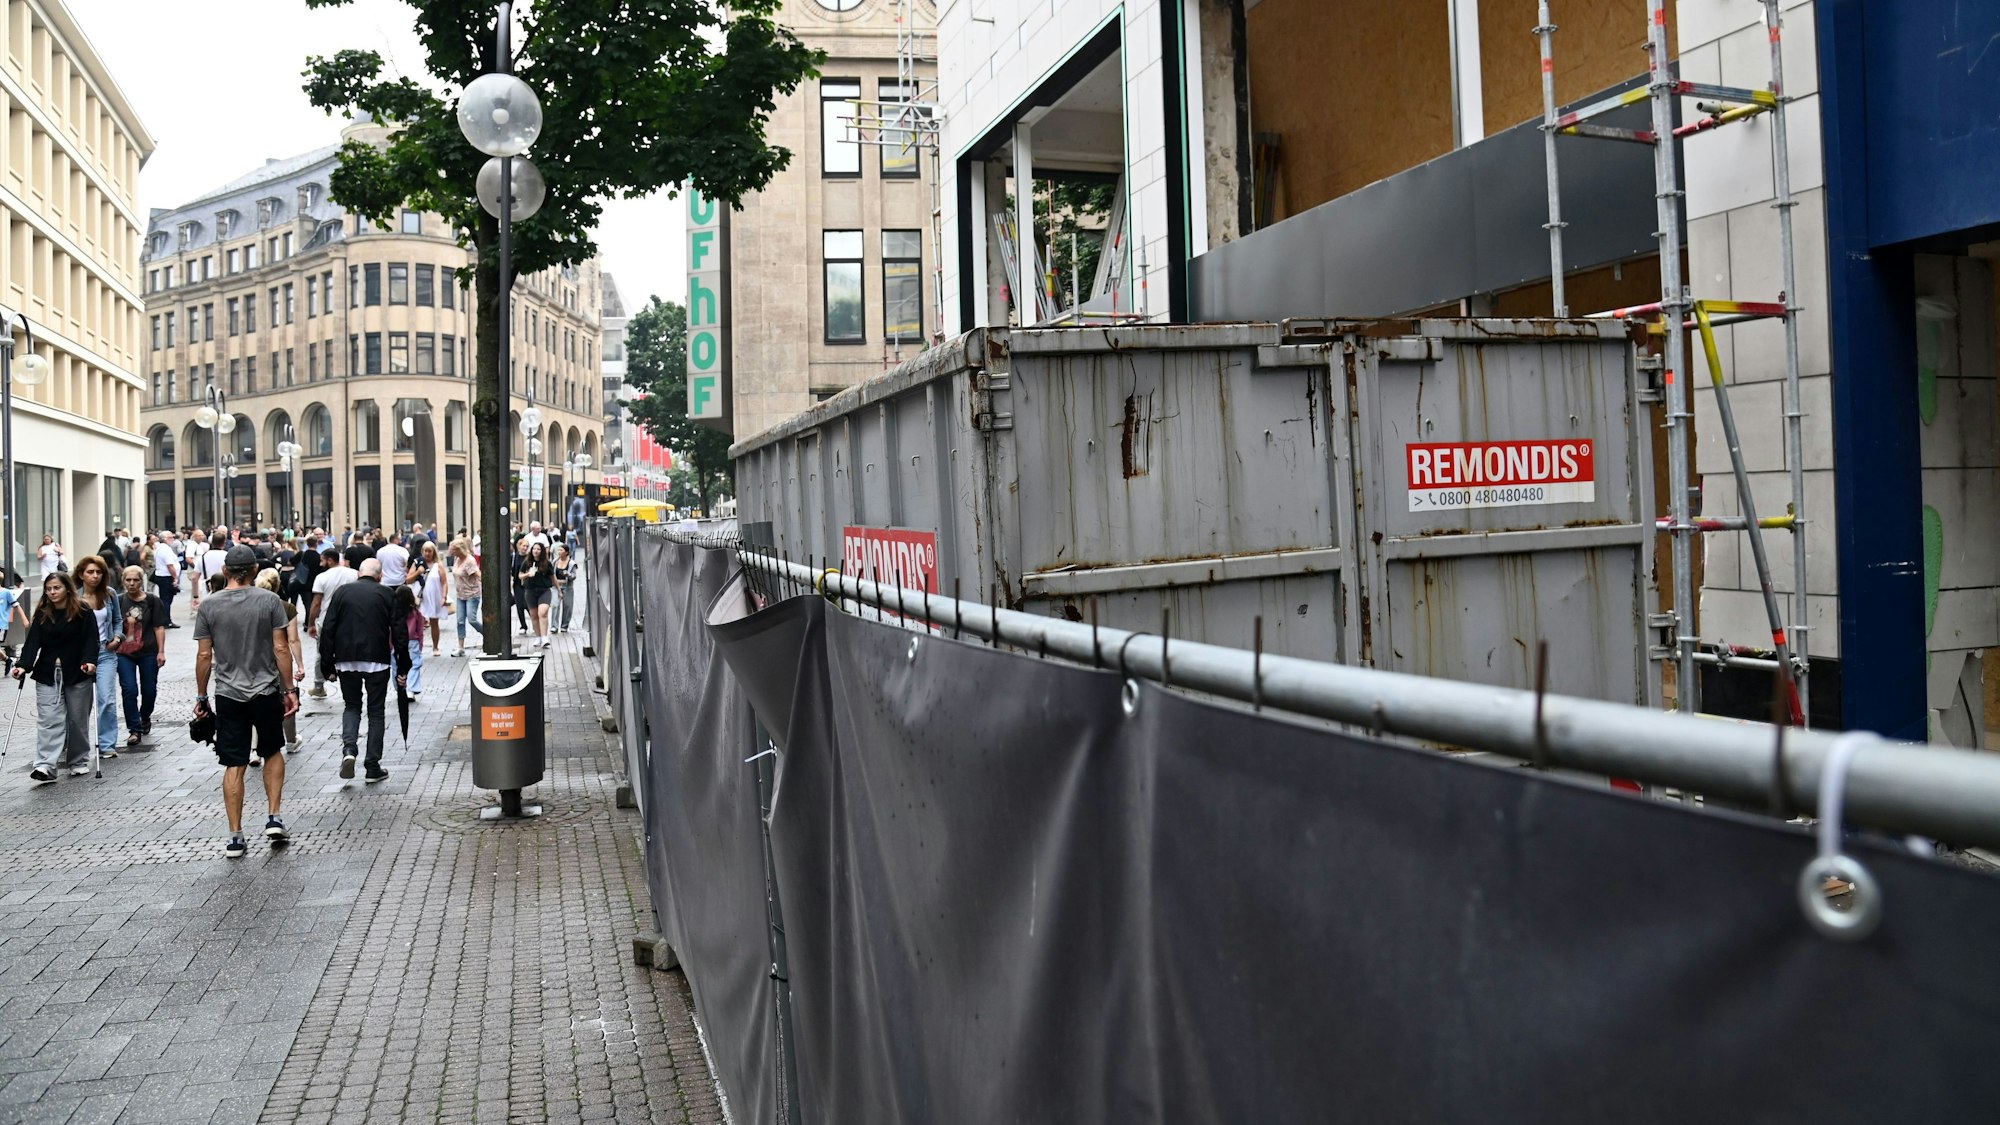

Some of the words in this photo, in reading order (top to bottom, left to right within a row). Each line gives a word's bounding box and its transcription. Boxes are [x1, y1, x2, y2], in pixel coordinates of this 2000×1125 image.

[690, 186, 716, 416] UFhOF
[1439, 490, 1471, 506] 0800
[1475, 487, 1544, 504] 480480480
